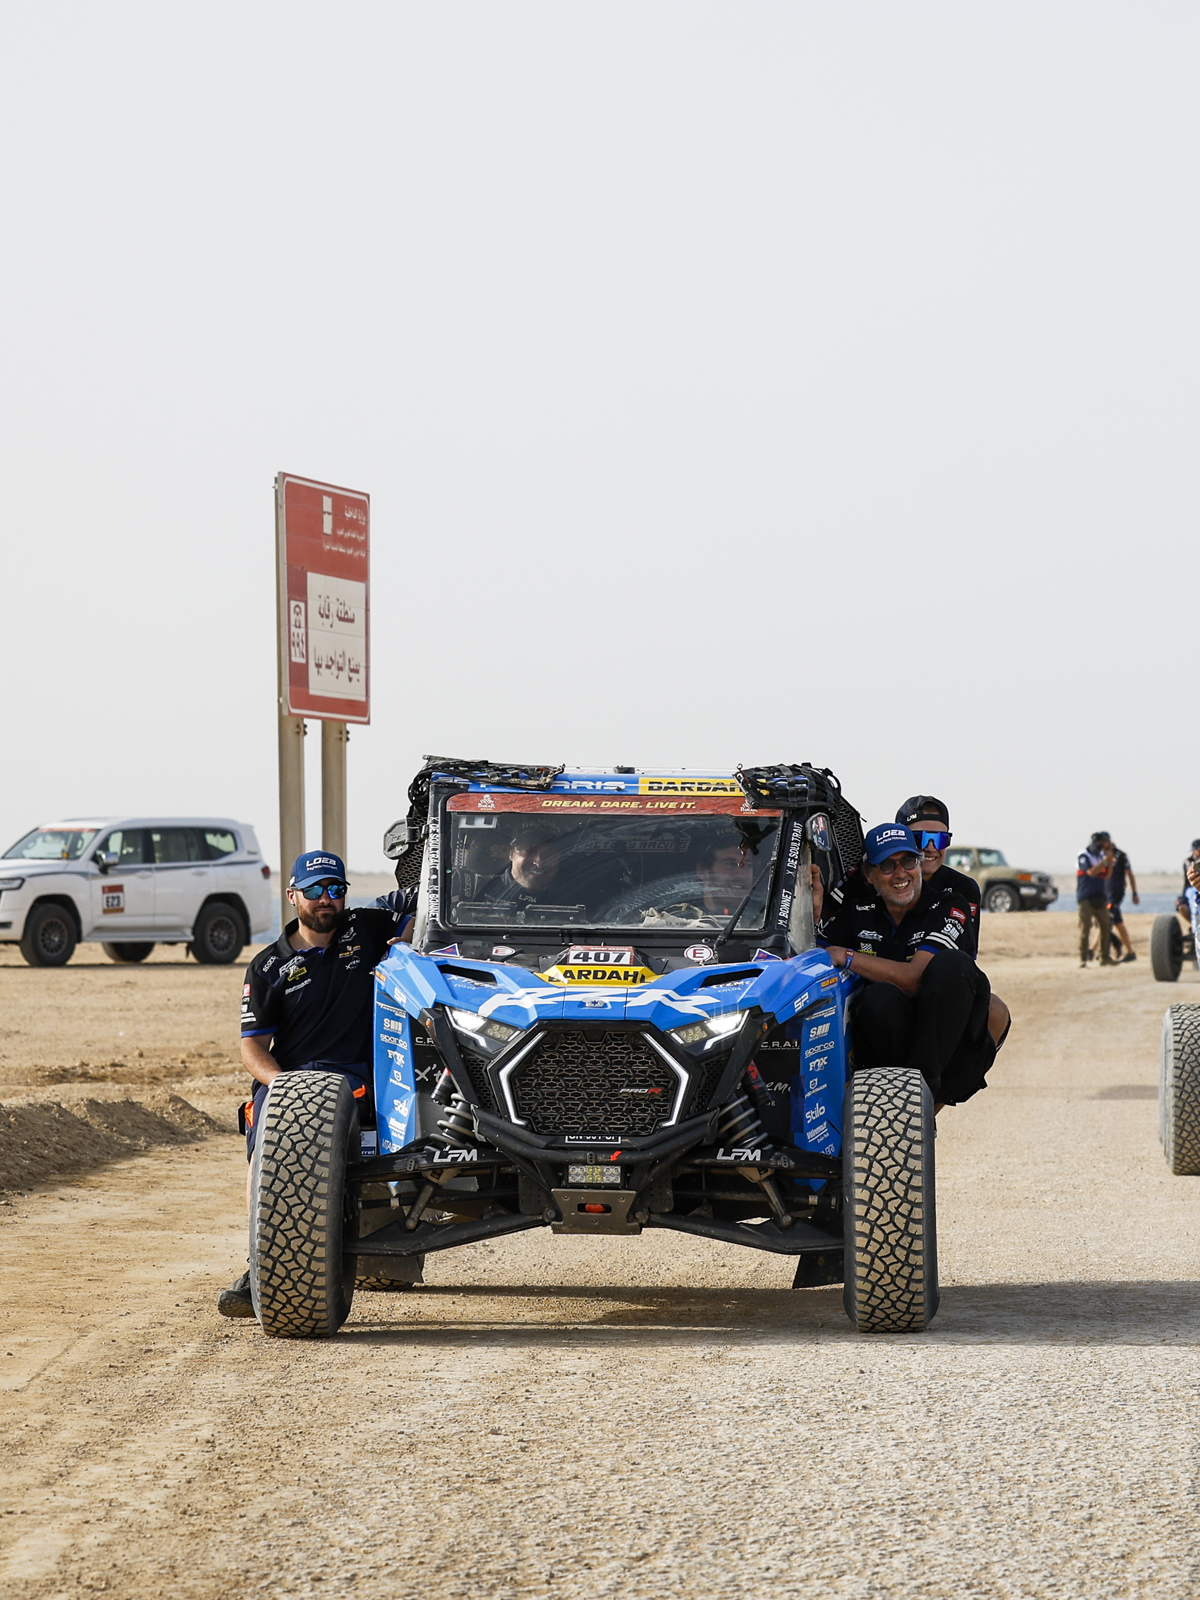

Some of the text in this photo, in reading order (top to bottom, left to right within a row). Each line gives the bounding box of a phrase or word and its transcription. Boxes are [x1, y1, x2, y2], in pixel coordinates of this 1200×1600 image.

[542, 800, 597, 808] DREAM.
[788, 821, 804, 859] SOULTRAIT
[786, 858, 797, 869] DE
[779, 888, 793, 919] BONNET
[573, 951, 627, 963] 407
[804, 1040, 835, 1058] sparco
[809, 1056, 828, 1071] FOX
[805, 1102, 826, 1124] Stilo
[433, 1149, 478, 1162] LFM
[717, 1148, 761, 1161] LFM
